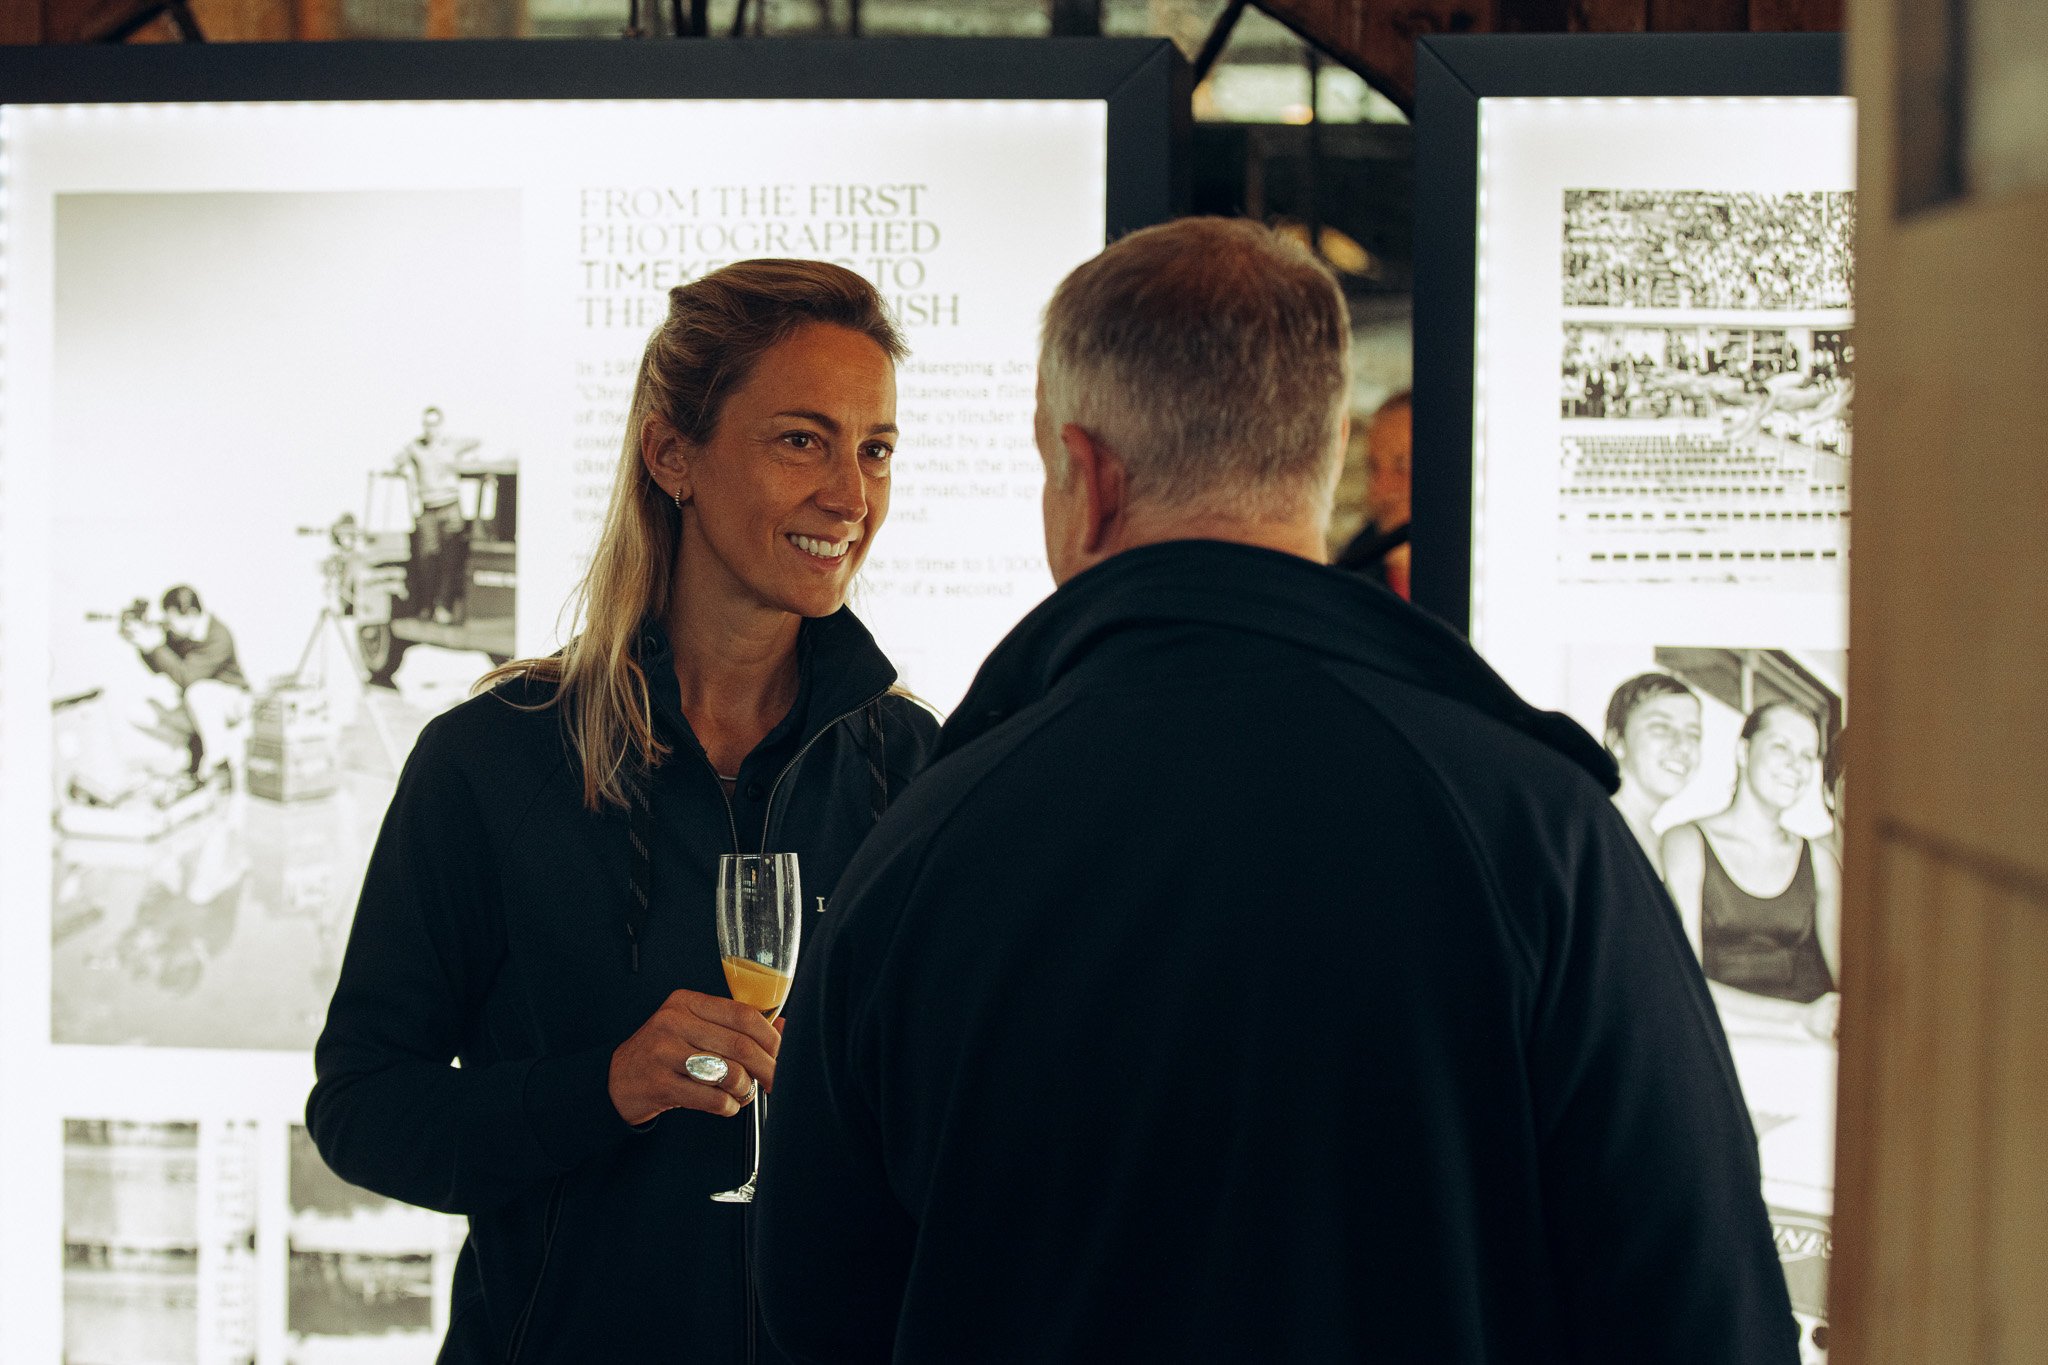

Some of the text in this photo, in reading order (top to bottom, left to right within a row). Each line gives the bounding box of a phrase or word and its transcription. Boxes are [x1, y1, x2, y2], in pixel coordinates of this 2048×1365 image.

[580, 184, 928, 218] FROM THE FIRST
[579, 221, 942, 255] PHOTOGRAPHED
[866, 258, 927, 290] TO
